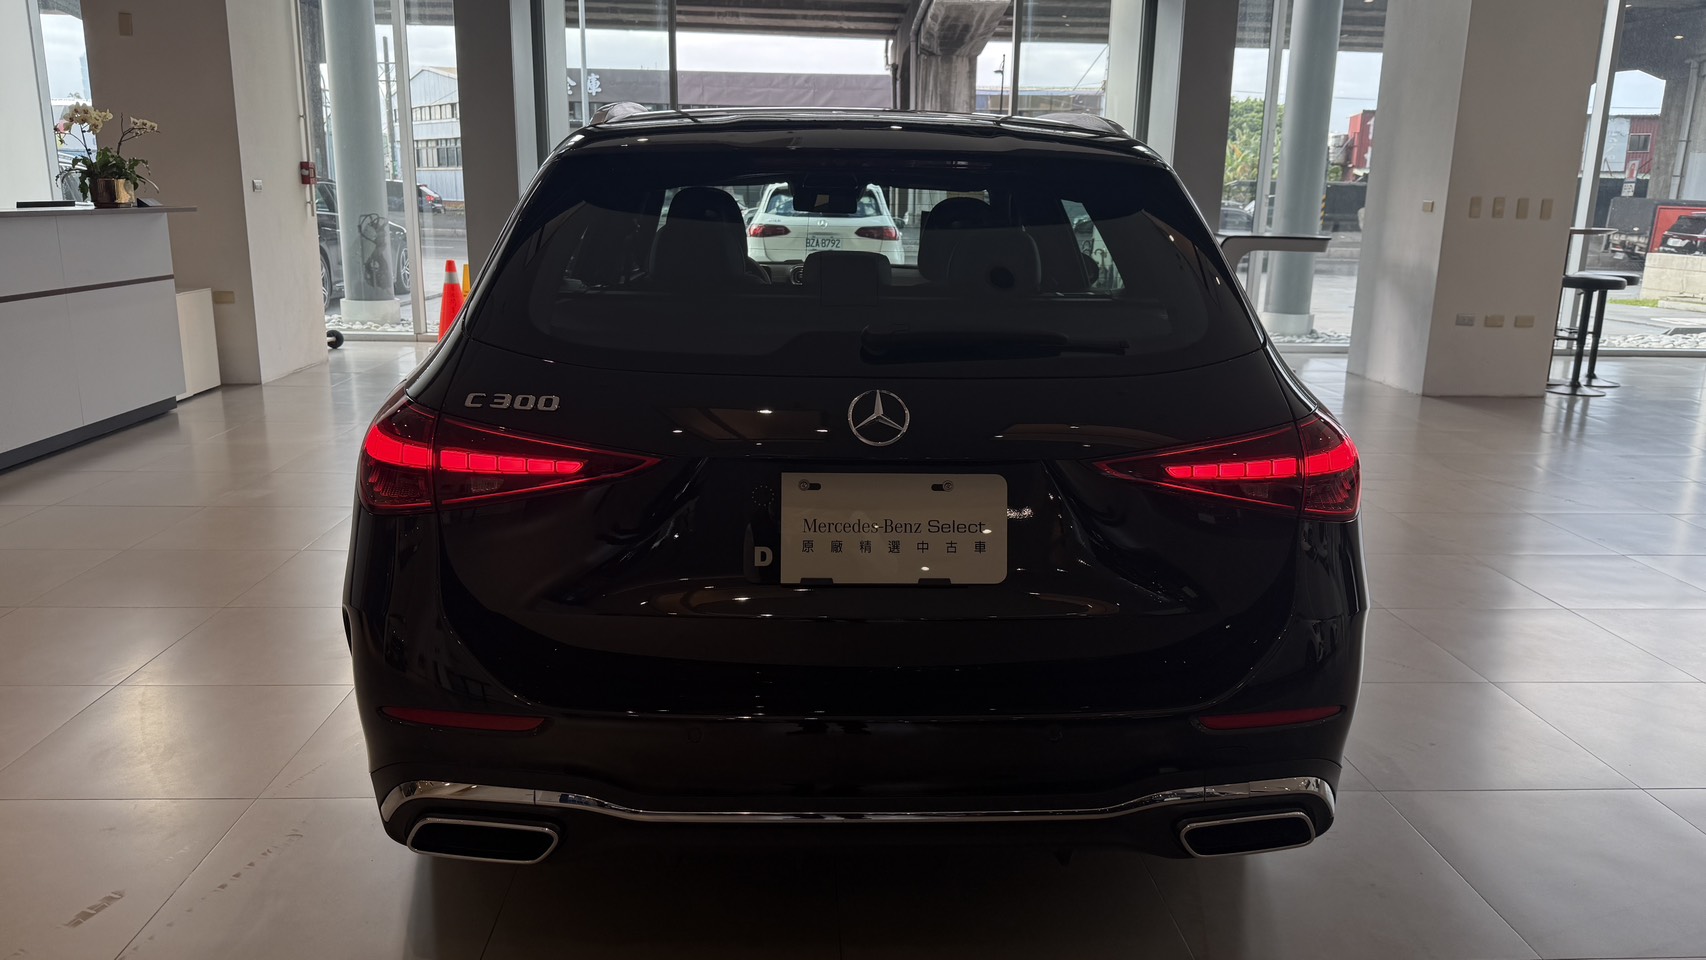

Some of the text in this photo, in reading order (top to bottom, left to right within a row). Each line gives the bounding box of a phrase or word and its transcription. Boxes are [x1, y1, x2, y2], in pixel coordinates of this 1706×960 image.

[464, 392, 560, 411] C 300
[802, 518, 986, 534] Mercedes-Benz Select
[801, 539, 986, 554] 原廠精選中古車
[754, 546, 773, 567] D
